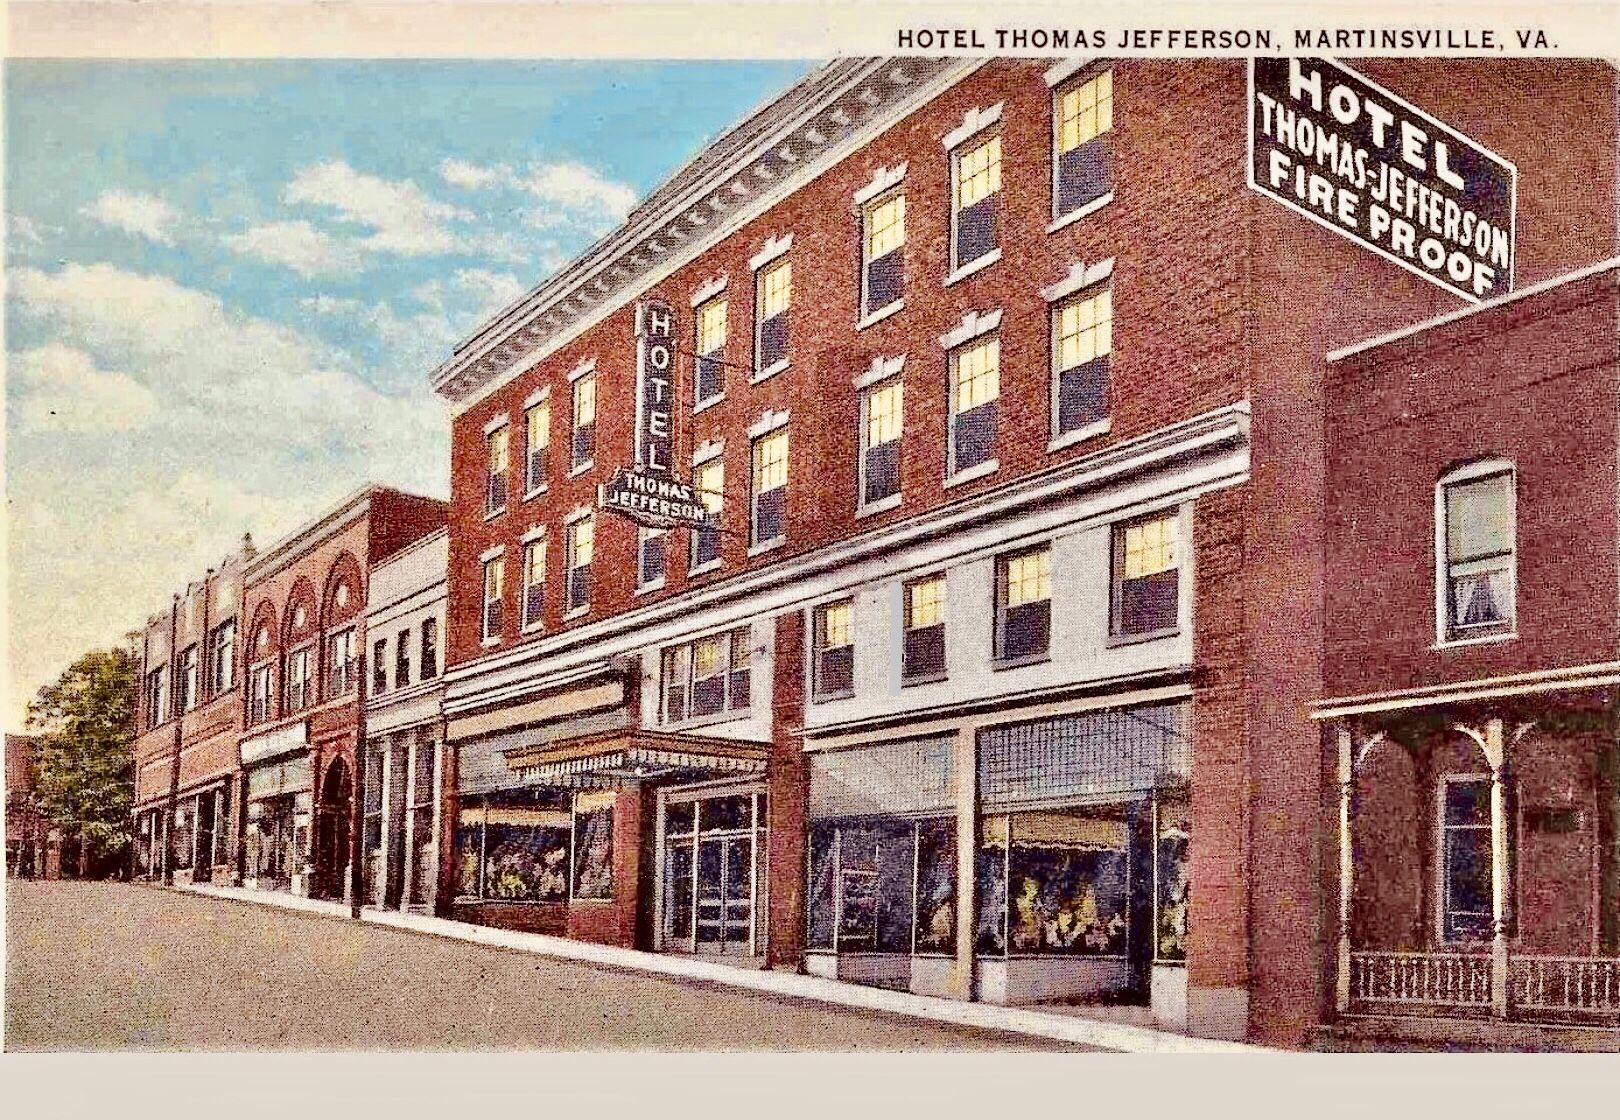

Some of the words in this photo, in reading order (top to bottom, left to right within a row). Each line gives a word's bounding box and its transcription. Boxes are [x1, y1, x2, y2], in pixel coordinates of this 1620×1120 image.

[1257, 92, 1509, 269] THOMAS-JEFFERSON
[1289, 57, 1465, 190] HOTEL
[1269, 149, 1359, 228] FIRE
[1369, 204, 1495, 295] PROOF
[649, 310, 670, 471] HOTEL
[608, 490, 705, 521] JEFFERSON
[624, 473, 692, 500] THOMAS
